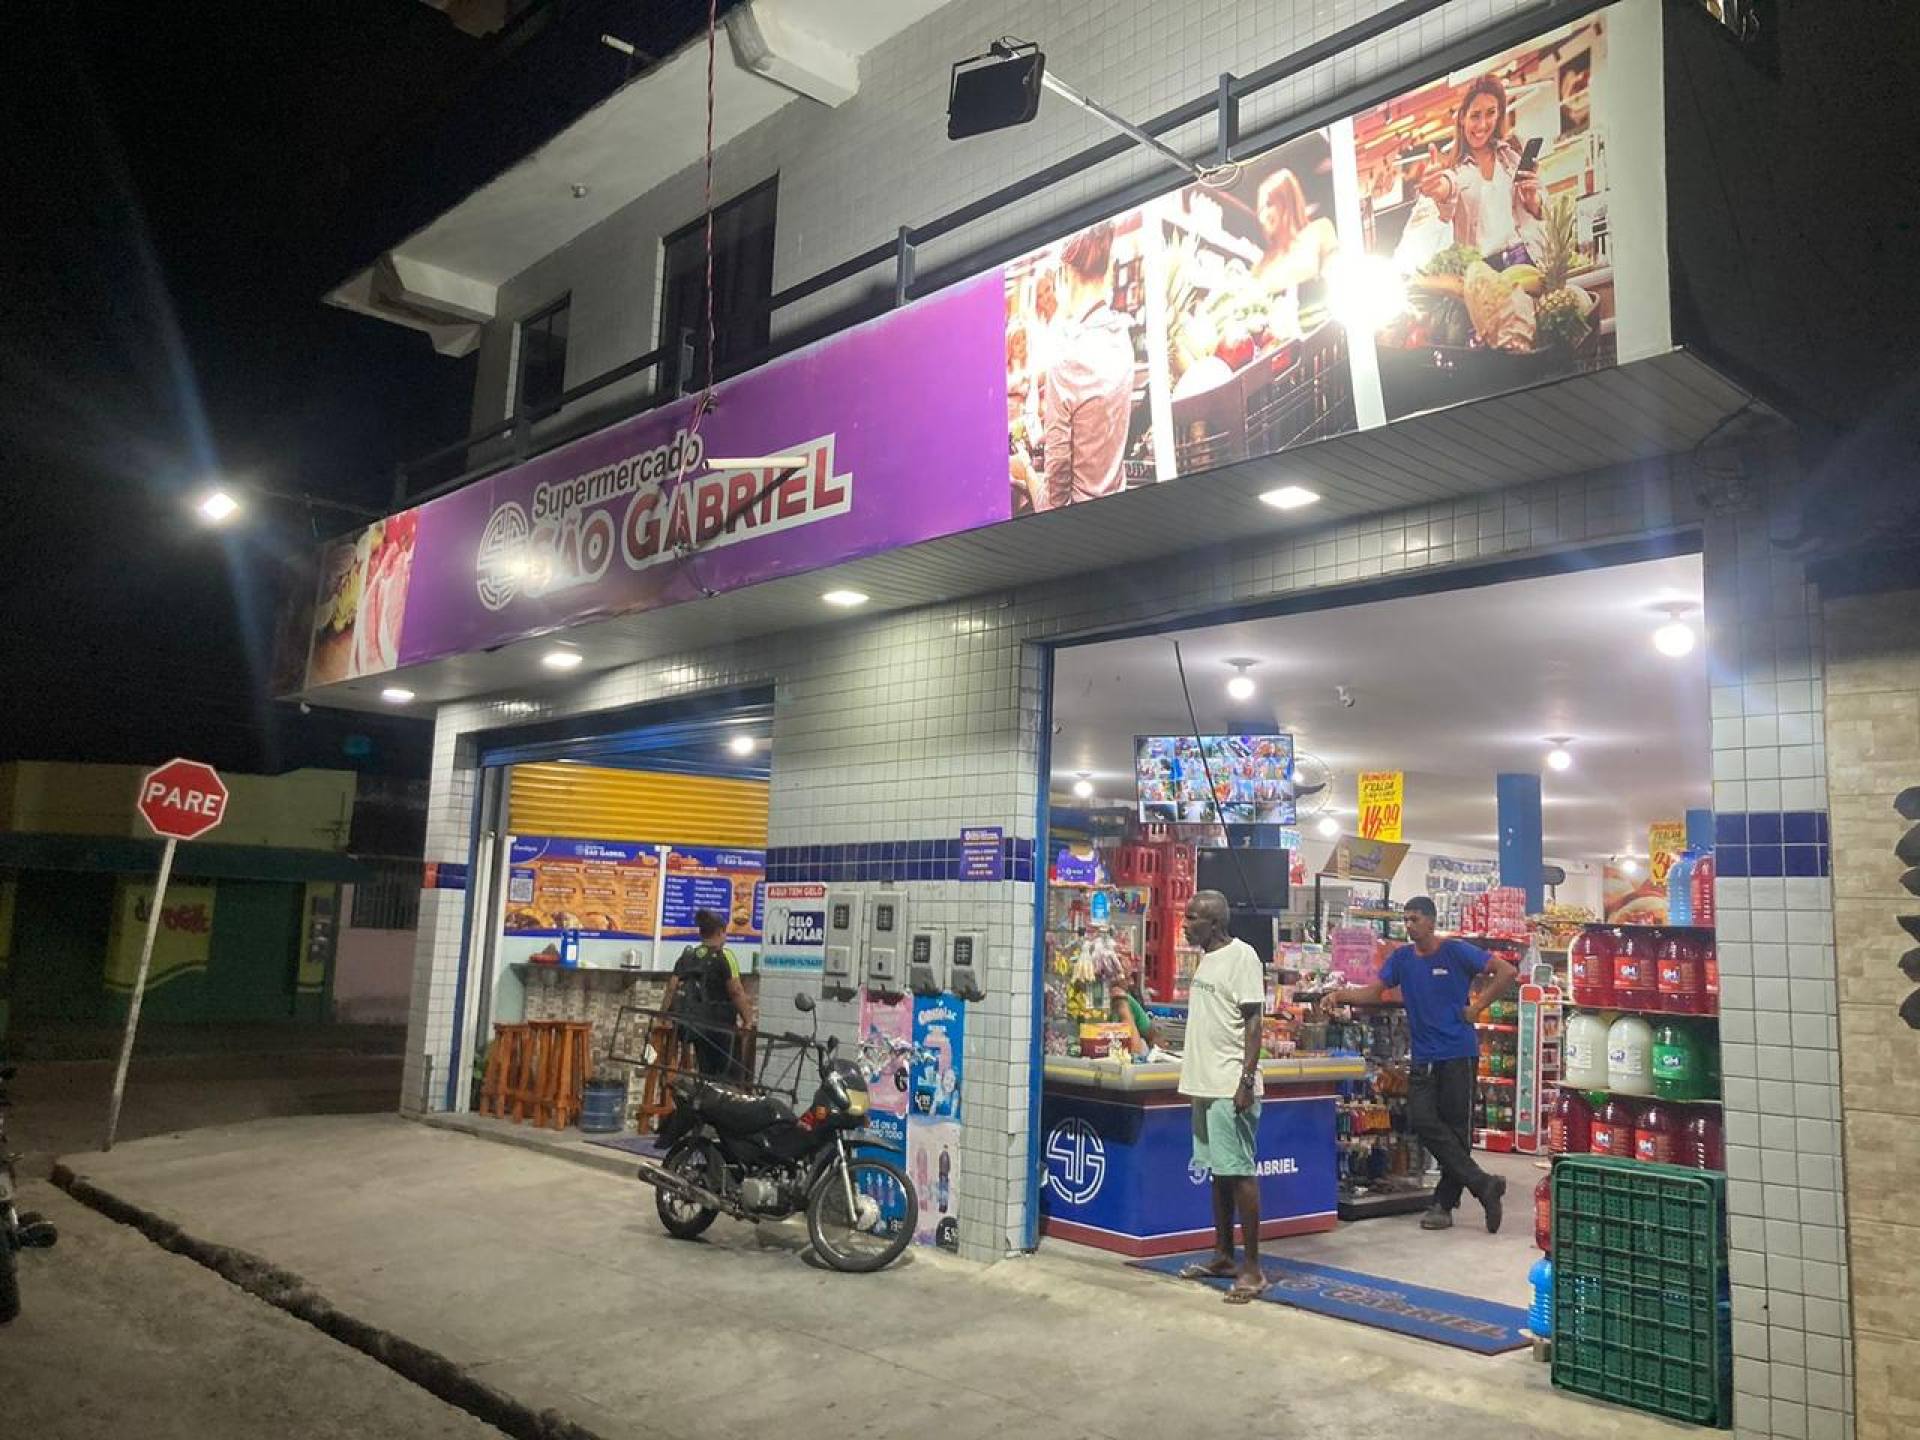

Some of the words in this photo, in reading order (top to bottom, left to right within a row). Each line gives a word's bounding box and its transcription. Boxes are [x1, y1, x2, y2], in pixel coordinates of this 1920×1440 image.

[534, 432, 702, 519] Supermercado
[626, 438, 849, 565] GABRIEL
[146, 781, 222, 817] PARE
[788, 916, 814, 928] GELO
[788, 928, 824, 941] POLAR
[1254, 1158, 1299, 1177] ABRIEL
